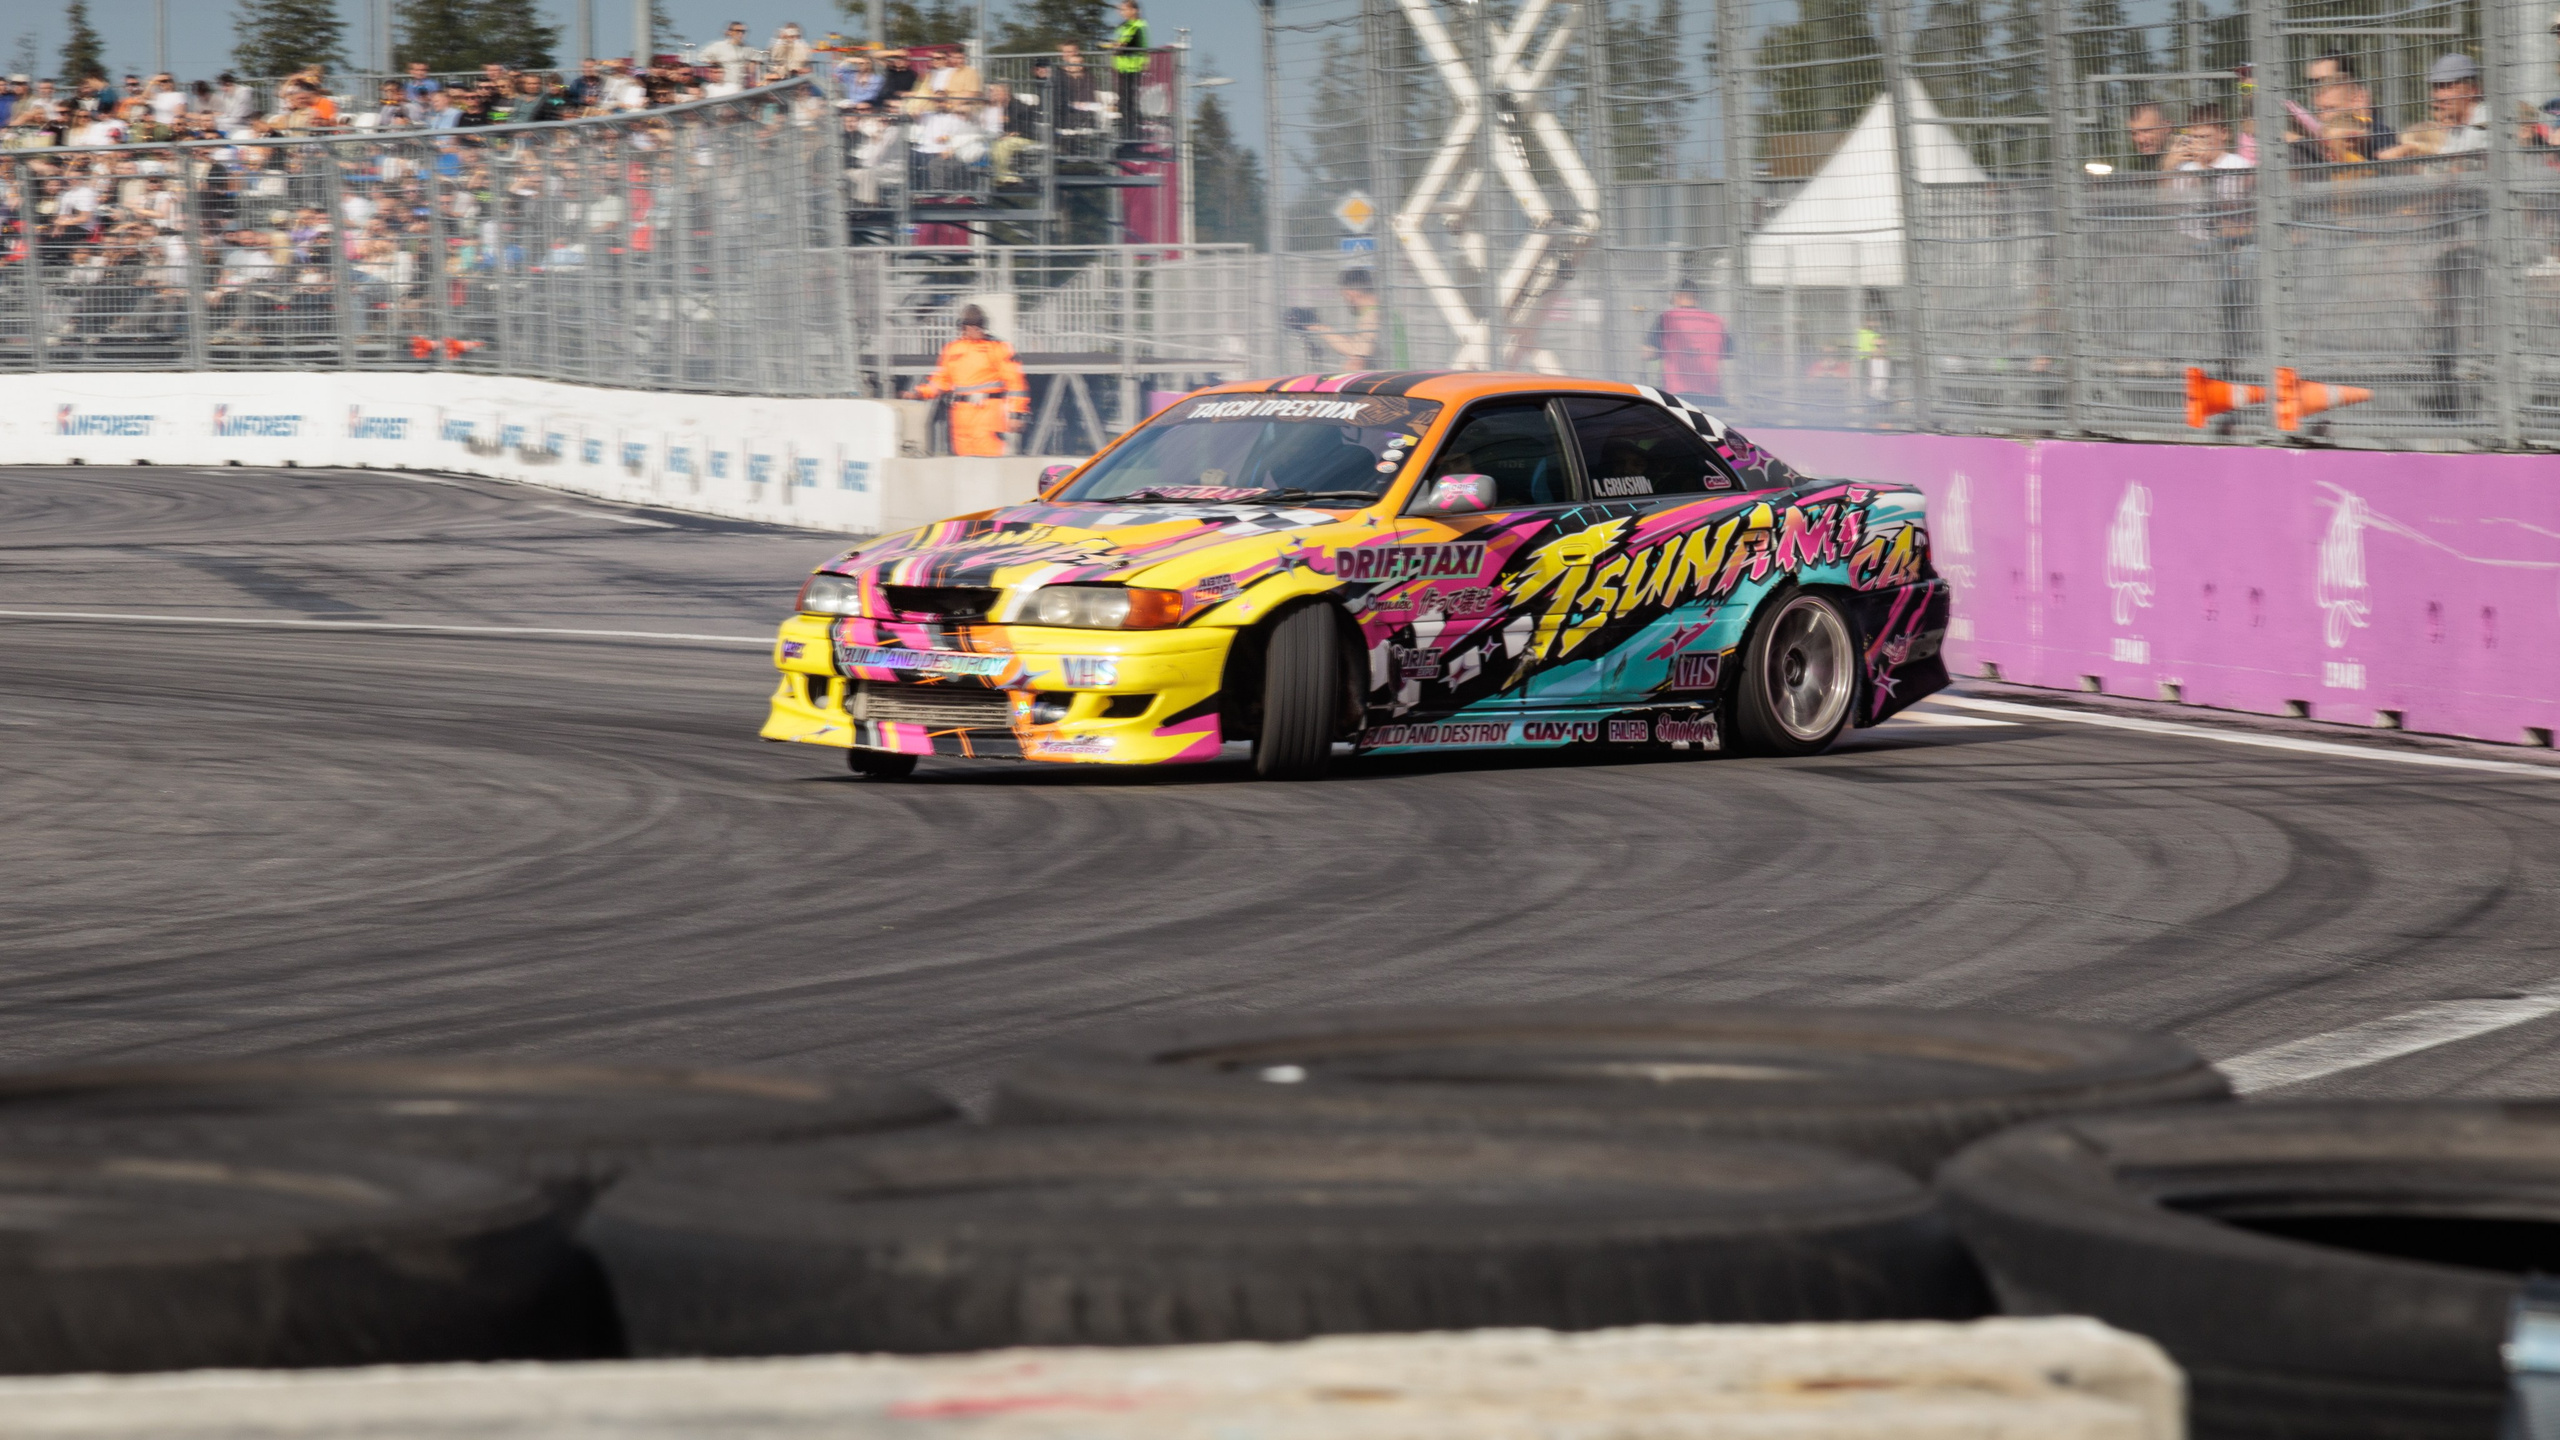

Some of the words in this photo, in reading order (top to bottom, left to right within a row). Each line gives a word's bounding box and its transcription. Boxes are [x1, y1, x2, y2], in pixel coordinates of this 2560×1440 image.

[1187, 400, 1254, 418] ТАКСИ
[1250, 400, 1370, 420] ПРЕСТИЖ
[1336, 546, 1417, 579] DRIFT
[1419, 544, 1485, 577] TAXI
[841, 647, 883, 664] BUILD
[885, 650, 920, 667] AND
[920, 652, 1010, 674] DESTROY
[1062, 657, 1118, 686] VHS
[1679, 655, 1718, 686] VHS
[1361, 724, 1405, 746] BUILD
[1405, 723, 1440, 744] AND
[1440, 722, 1512, 744] DESTROY
[1656, 713, 1717, 742] Smokers
